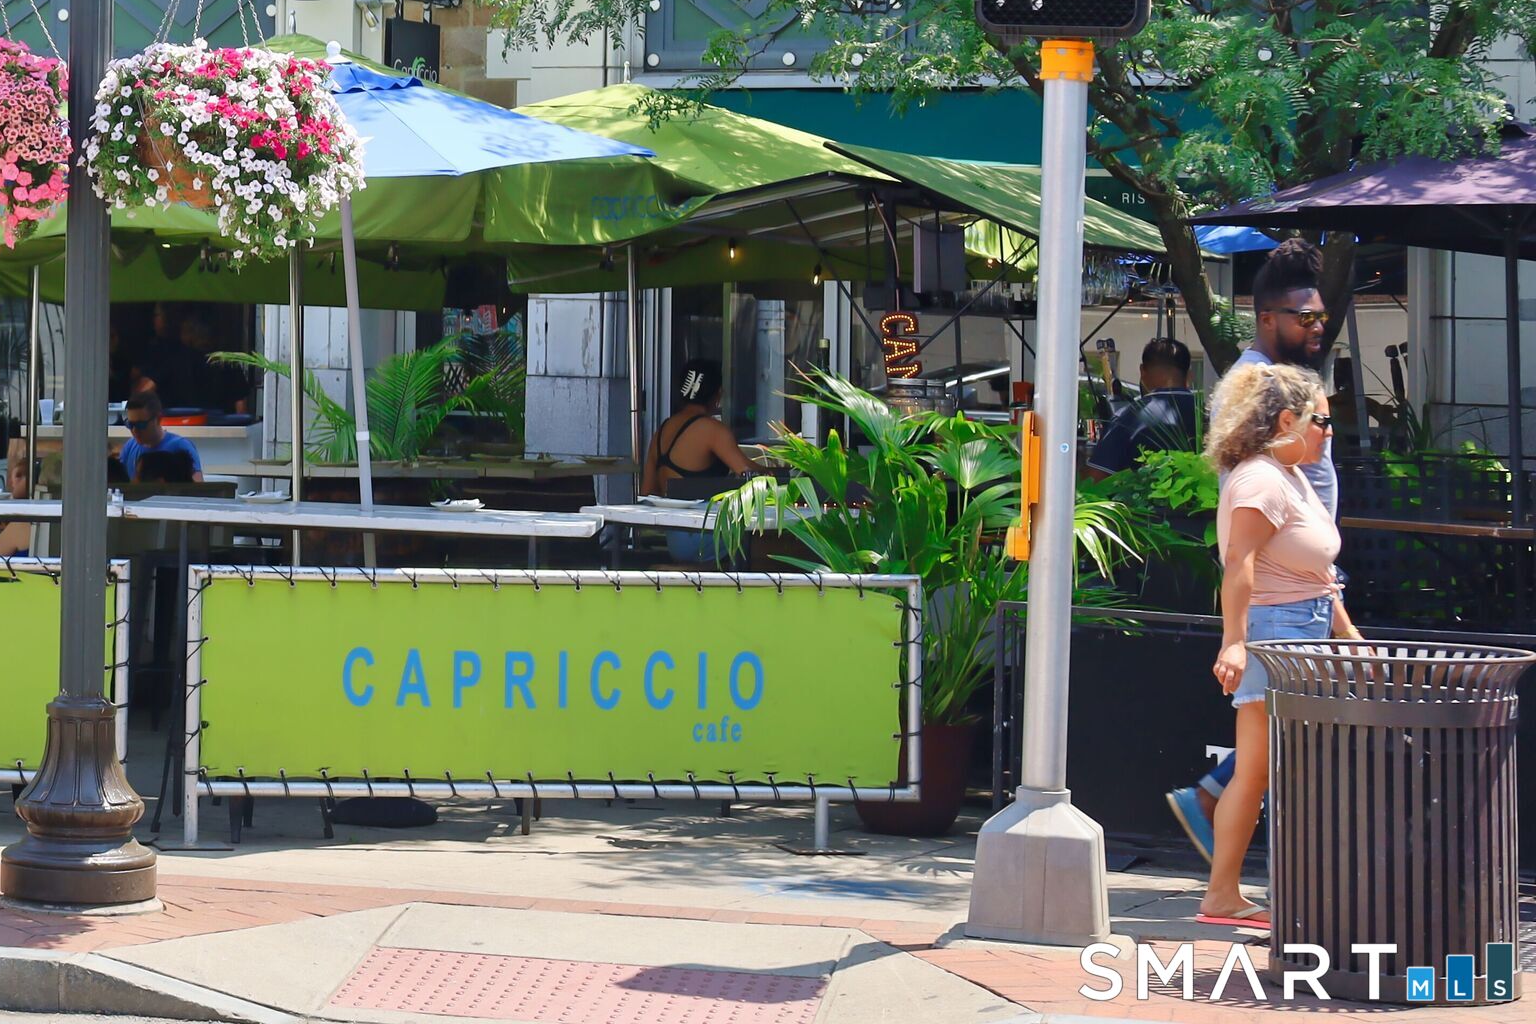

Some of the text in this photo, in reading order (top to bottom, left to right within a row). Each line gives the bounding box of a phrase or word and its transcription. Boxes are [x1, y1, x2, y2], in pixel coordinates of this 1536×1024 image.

[1122, 192, 1146, 204] RIS
[342, 646, 764, 710] CAPRICCIO
[692, 715, 743, 743] cafe
